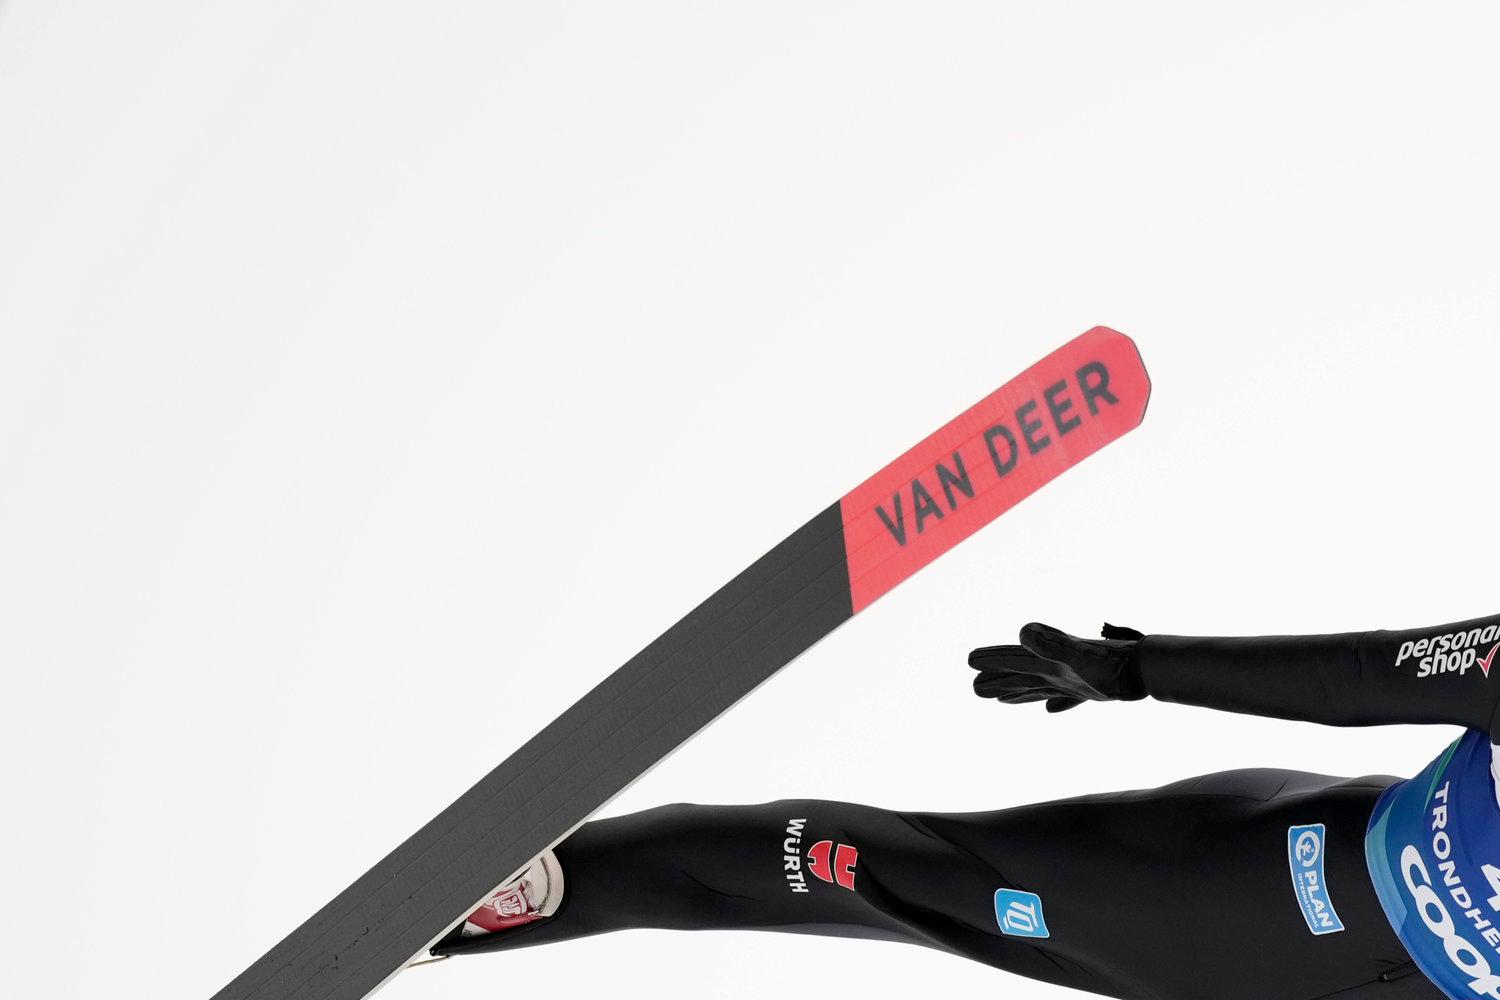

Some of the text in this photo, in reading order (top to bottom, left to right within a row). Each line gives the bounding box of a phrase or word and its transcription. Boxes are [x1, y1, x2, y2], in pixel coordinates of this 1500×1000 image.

[874, 360, 1120, 546] VAN DEER
[1417, 648, 1476, 678] shop
[783, 818, 809, 893] WÜRTH
[1003, 901, 1038, 932] TQ
[1297, 872, 1320, 929] INTERNATIONAL
[1304, 870, 1334, 927] PLAN
